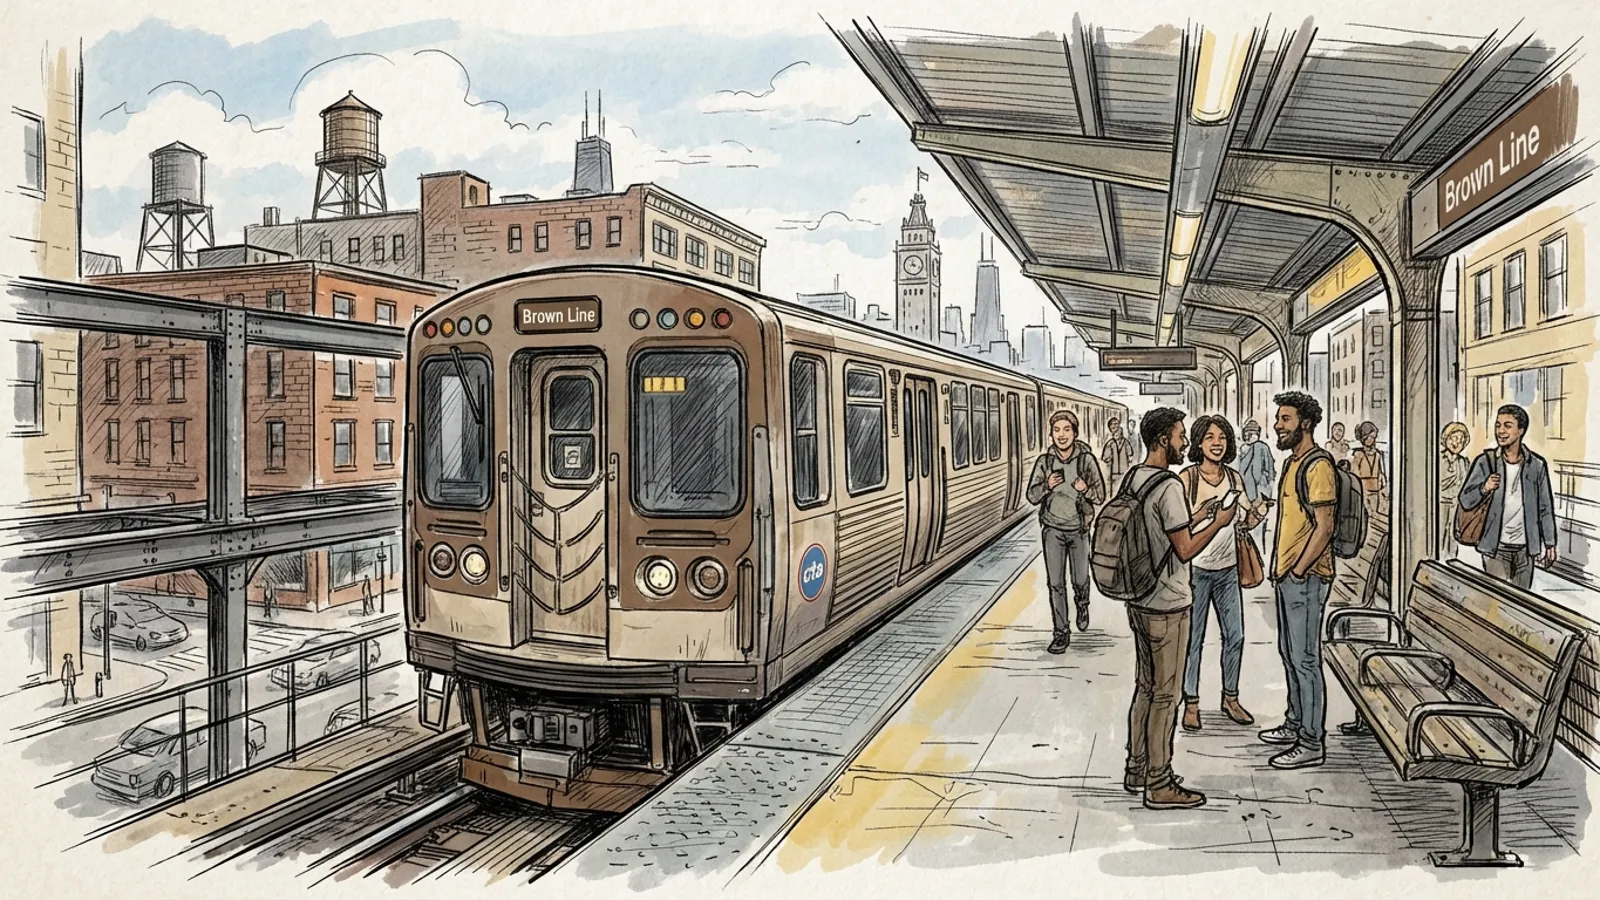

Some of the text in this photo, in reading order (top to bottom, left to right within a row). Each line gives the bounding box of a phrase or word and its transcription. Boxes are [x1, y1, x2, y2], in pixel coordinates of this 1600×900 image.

[1445, 125, 1540, 213] Brown Line
[523, 307, 595, 324] Brown Line
